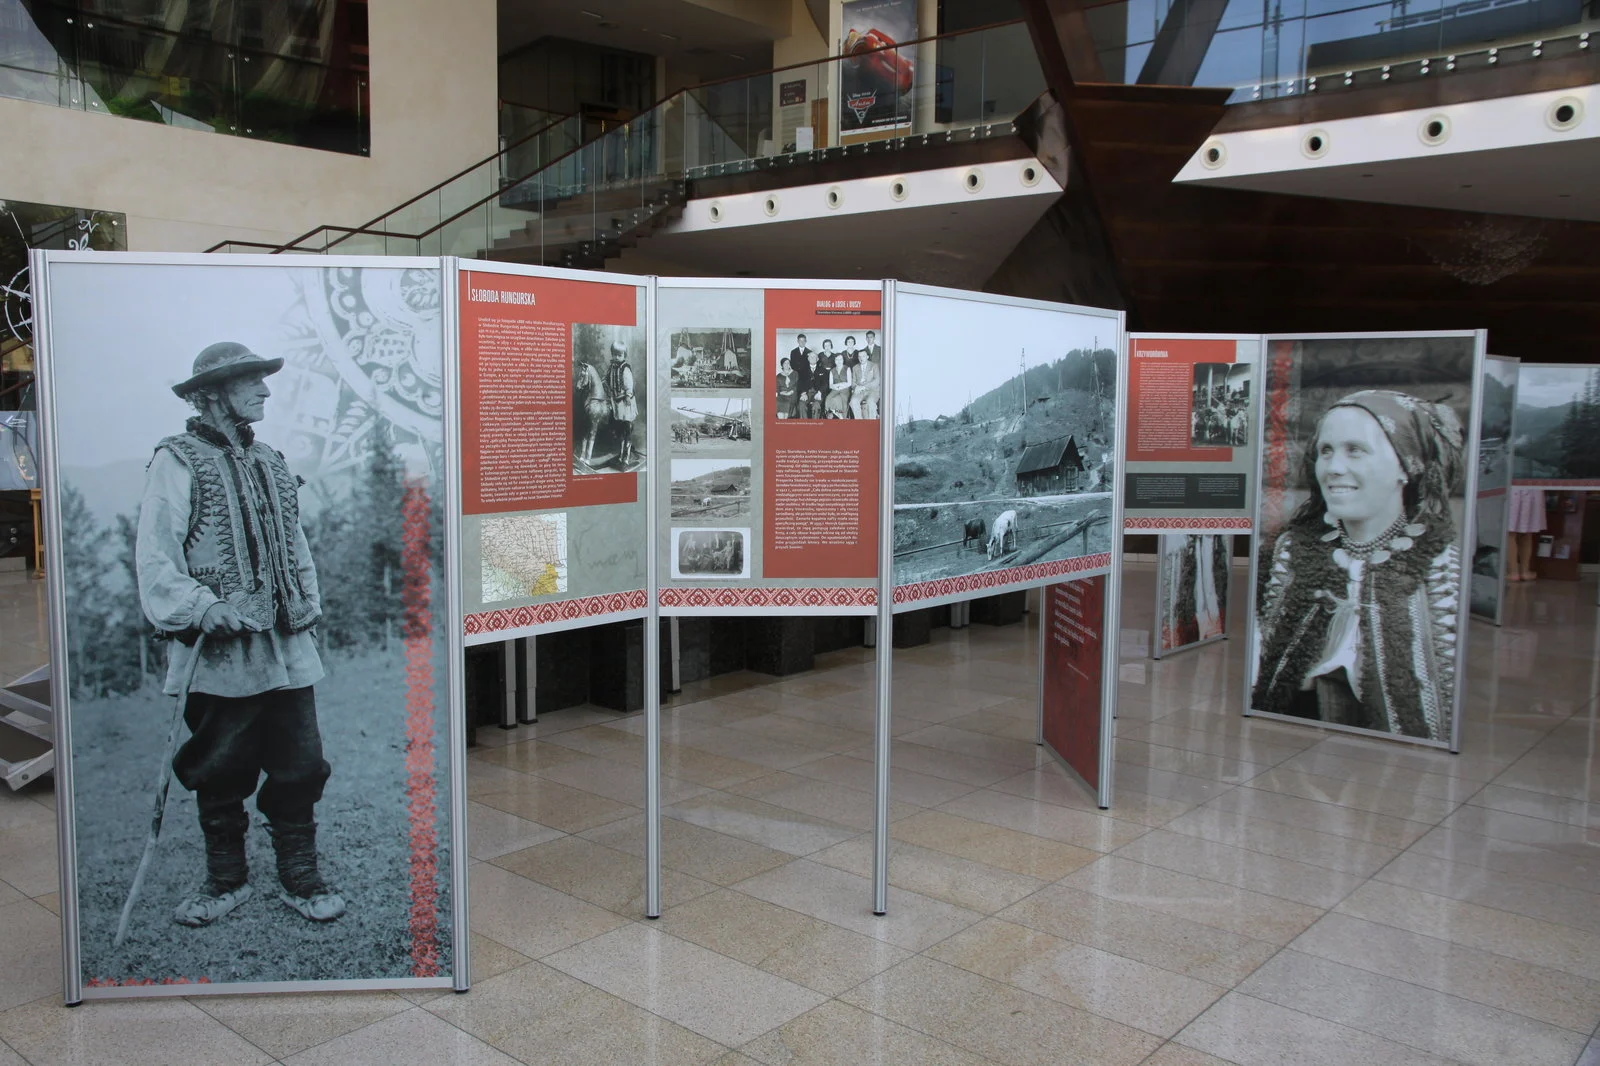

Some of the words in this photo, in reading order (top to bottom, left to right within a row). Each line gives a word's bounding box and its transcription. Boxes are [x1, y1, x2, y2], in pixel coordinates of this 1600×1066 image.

[471, 288, 500, 303] SŁOBODA
[500, 290, 536, 306] RUNGURSKA
[816, 300, 831, 308] DIALOG
